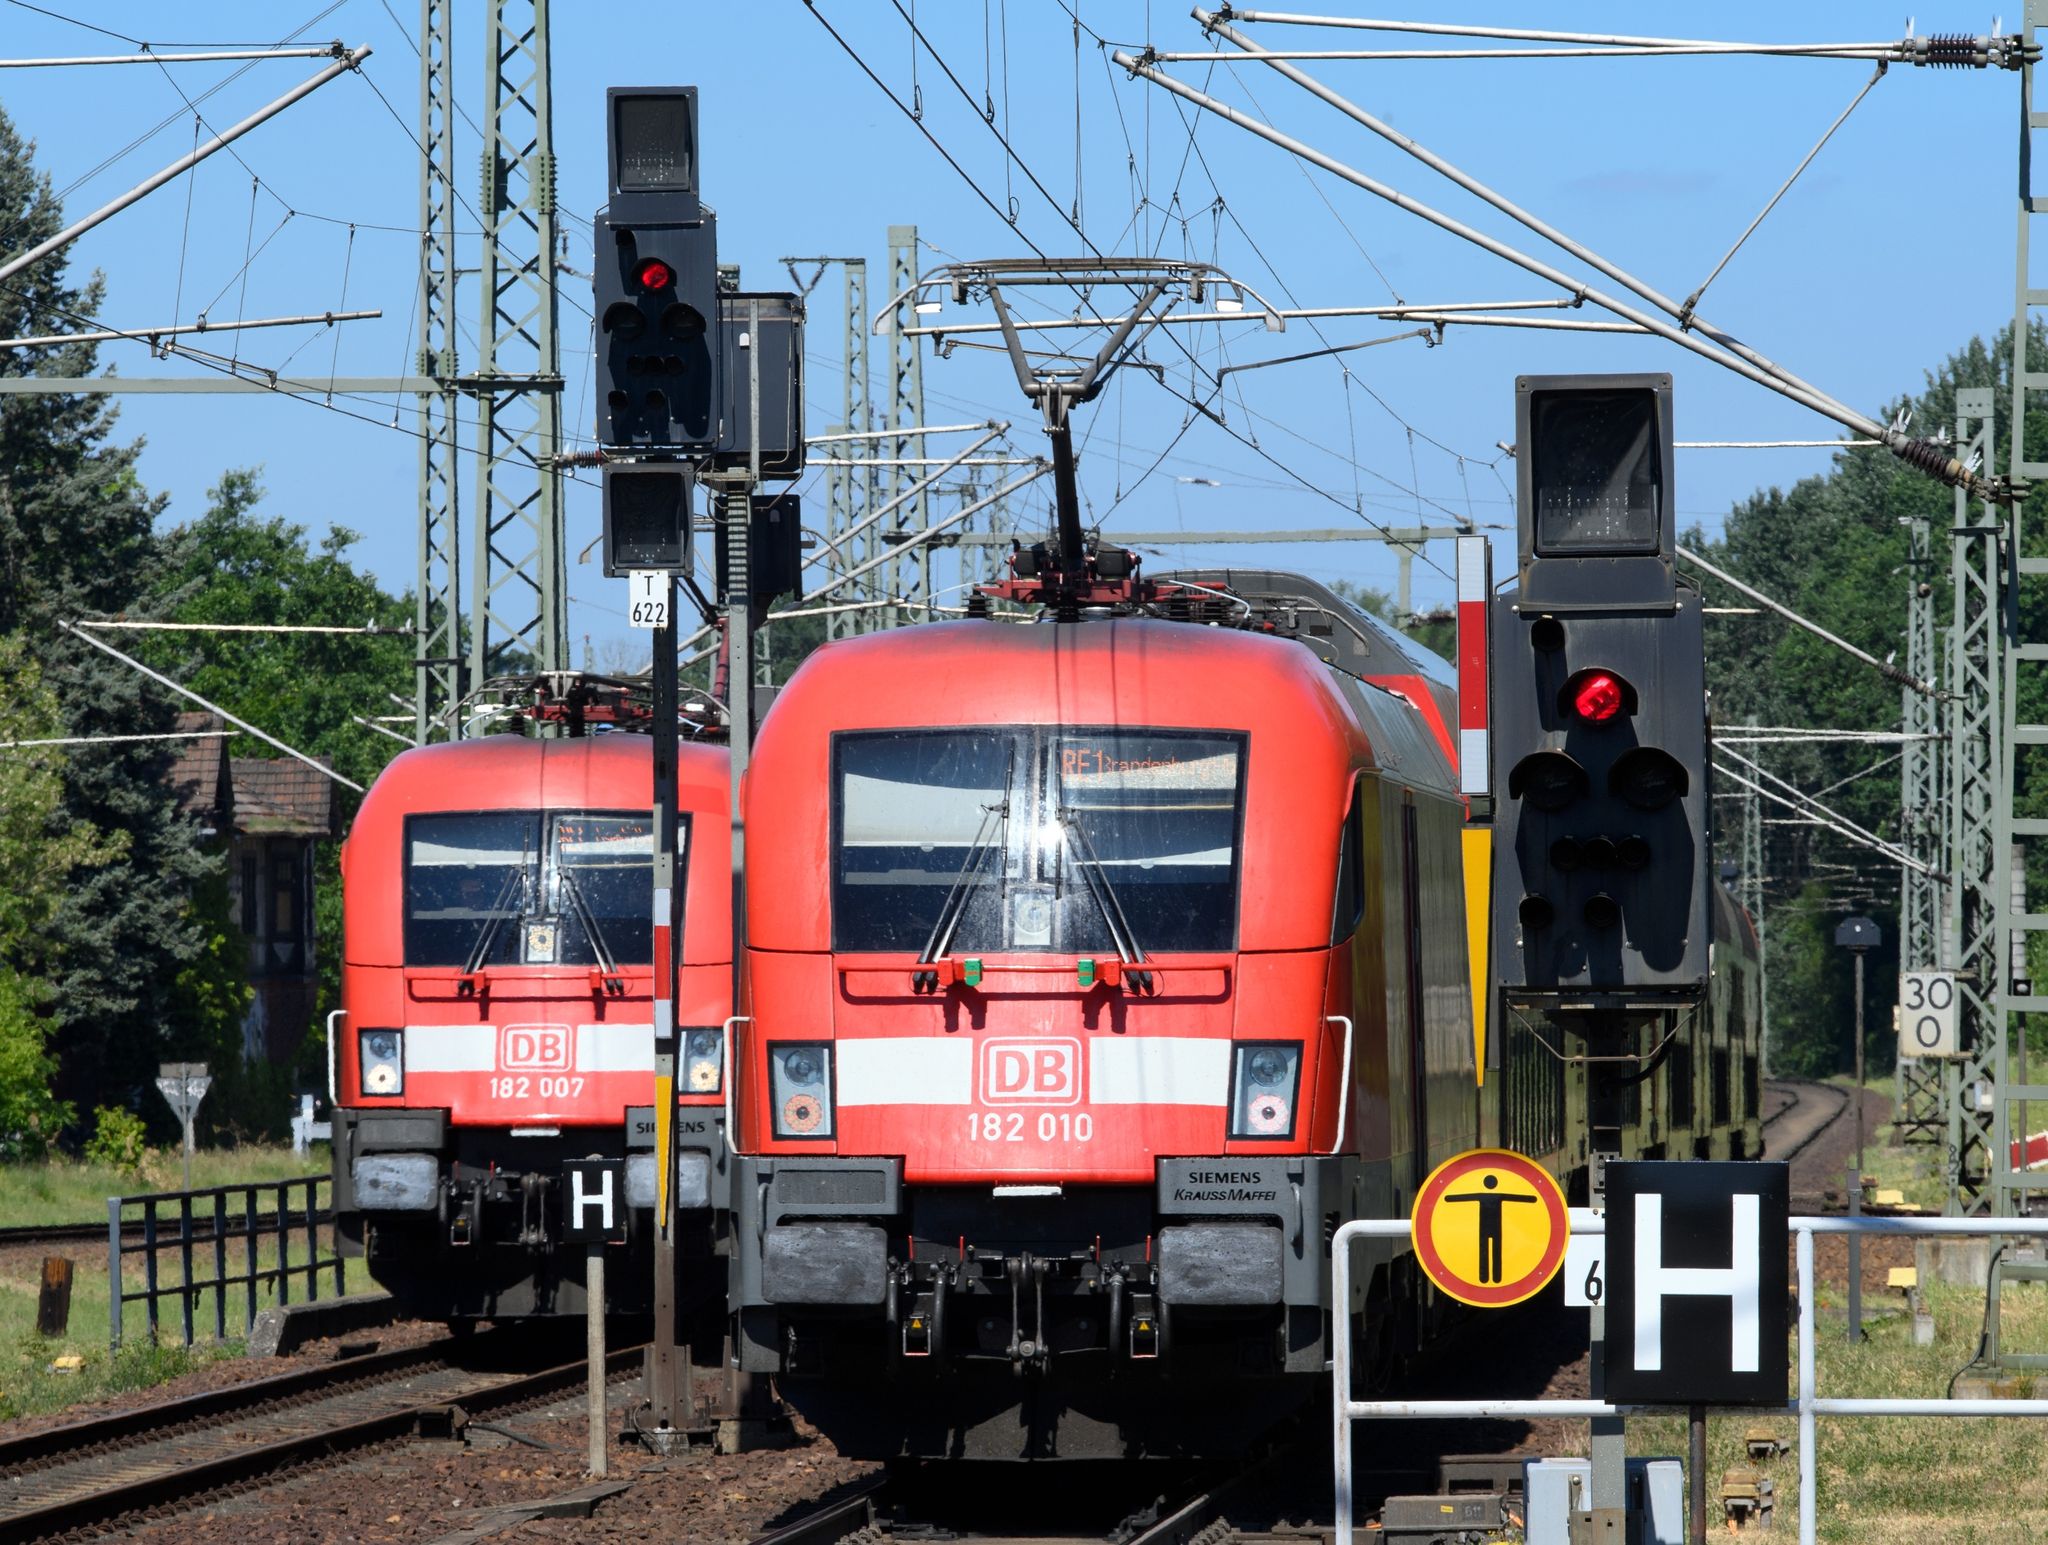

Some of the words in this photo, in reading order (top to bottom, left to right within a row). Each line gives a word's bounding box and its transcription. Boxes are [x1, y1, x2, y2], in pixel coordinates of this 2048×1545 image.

[643, 575, 654, 596] T
[632, 602, 665, 623] 622
[1905, 977, 1953, 1010] 30
[1916, 1015, 1941, 1048] 0
[512, 1033, 561, 1062] DB
[995, 1049, 1068, 1093] DB
[489, 1076, 529, 1099] 182
[539, 1076, 585, 1099] 007
[967, 1112, 1024, 1142] 182
[1037, 1112, 1093, 1142] 010
[1188, 1171, 1262, 1184] SIEMENS
[572, 1169, 614, 1229] H
[1633, 1193, 1760, 1372] H
